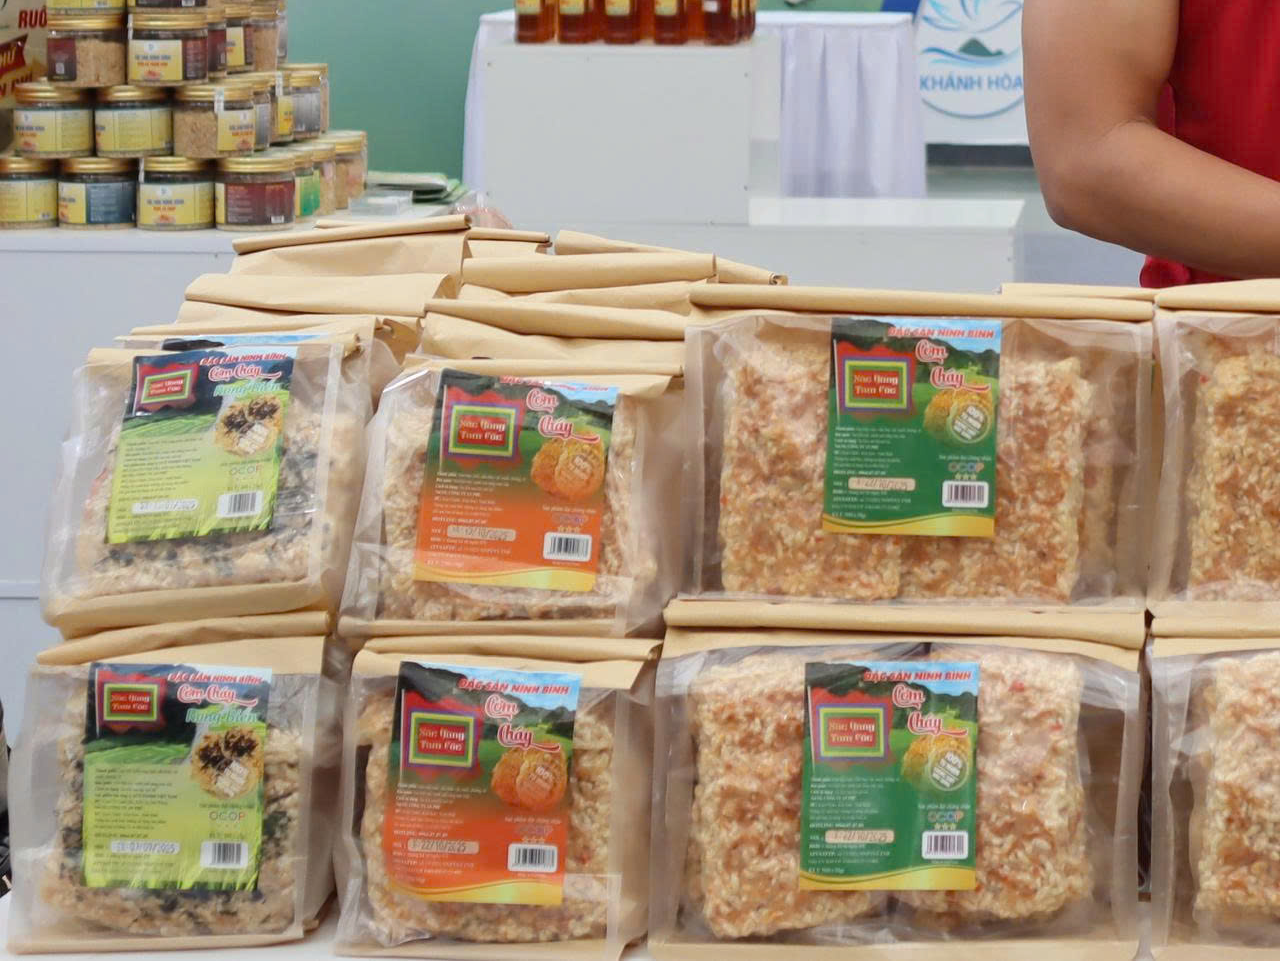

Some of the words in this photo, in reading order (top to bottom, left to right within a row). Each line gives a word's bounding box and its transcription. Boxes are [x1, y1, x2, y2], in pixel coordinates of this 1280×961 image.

[919, 72, 982, 91] KHÁNH
[987, 73, 1024, 90] HÒA
[915, 671, 942, 681] NINH
[511, 684, 540, 694] NINH
[543, 684, 569, 695] BÌNH
[907, 711, 968, 736] Cháy
[497, 723, 560, 753] Cháy
[209, 811, 245, 822] OCOP
